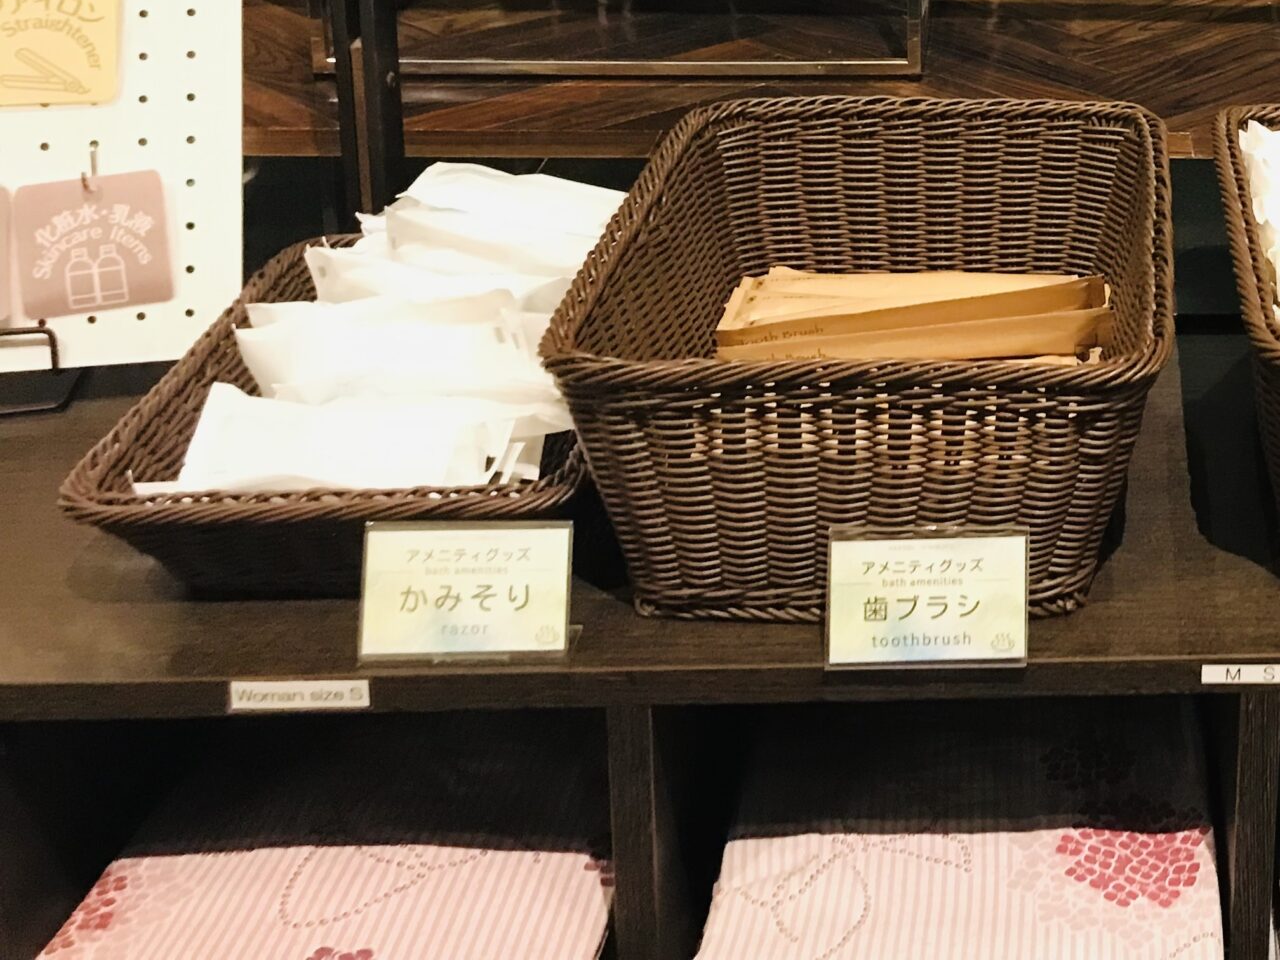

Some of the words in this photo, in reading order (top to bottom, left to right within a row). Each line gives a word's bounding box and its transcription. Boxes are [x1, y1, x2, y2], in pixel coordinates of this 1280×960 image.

[1, 13, 101, 69] Straightener
[406, 547, 531, 563] アメニティグッズ
[861, 557, 985, 576] アメニティグッズ
[881, 578, 908, 588] bath
[909, 577, 964, 588] amenities
[399, 584, 531, 613] かみそり
[863, 594, 981, 622] 歯ブラシ
[871, 632, 972, 649] toothbrush
[1225, 667, 1241, 682] M
[237, 689, 305, 703] Woman
[310, 688, 345, 702] size
[350, 687, 364, 702] S
